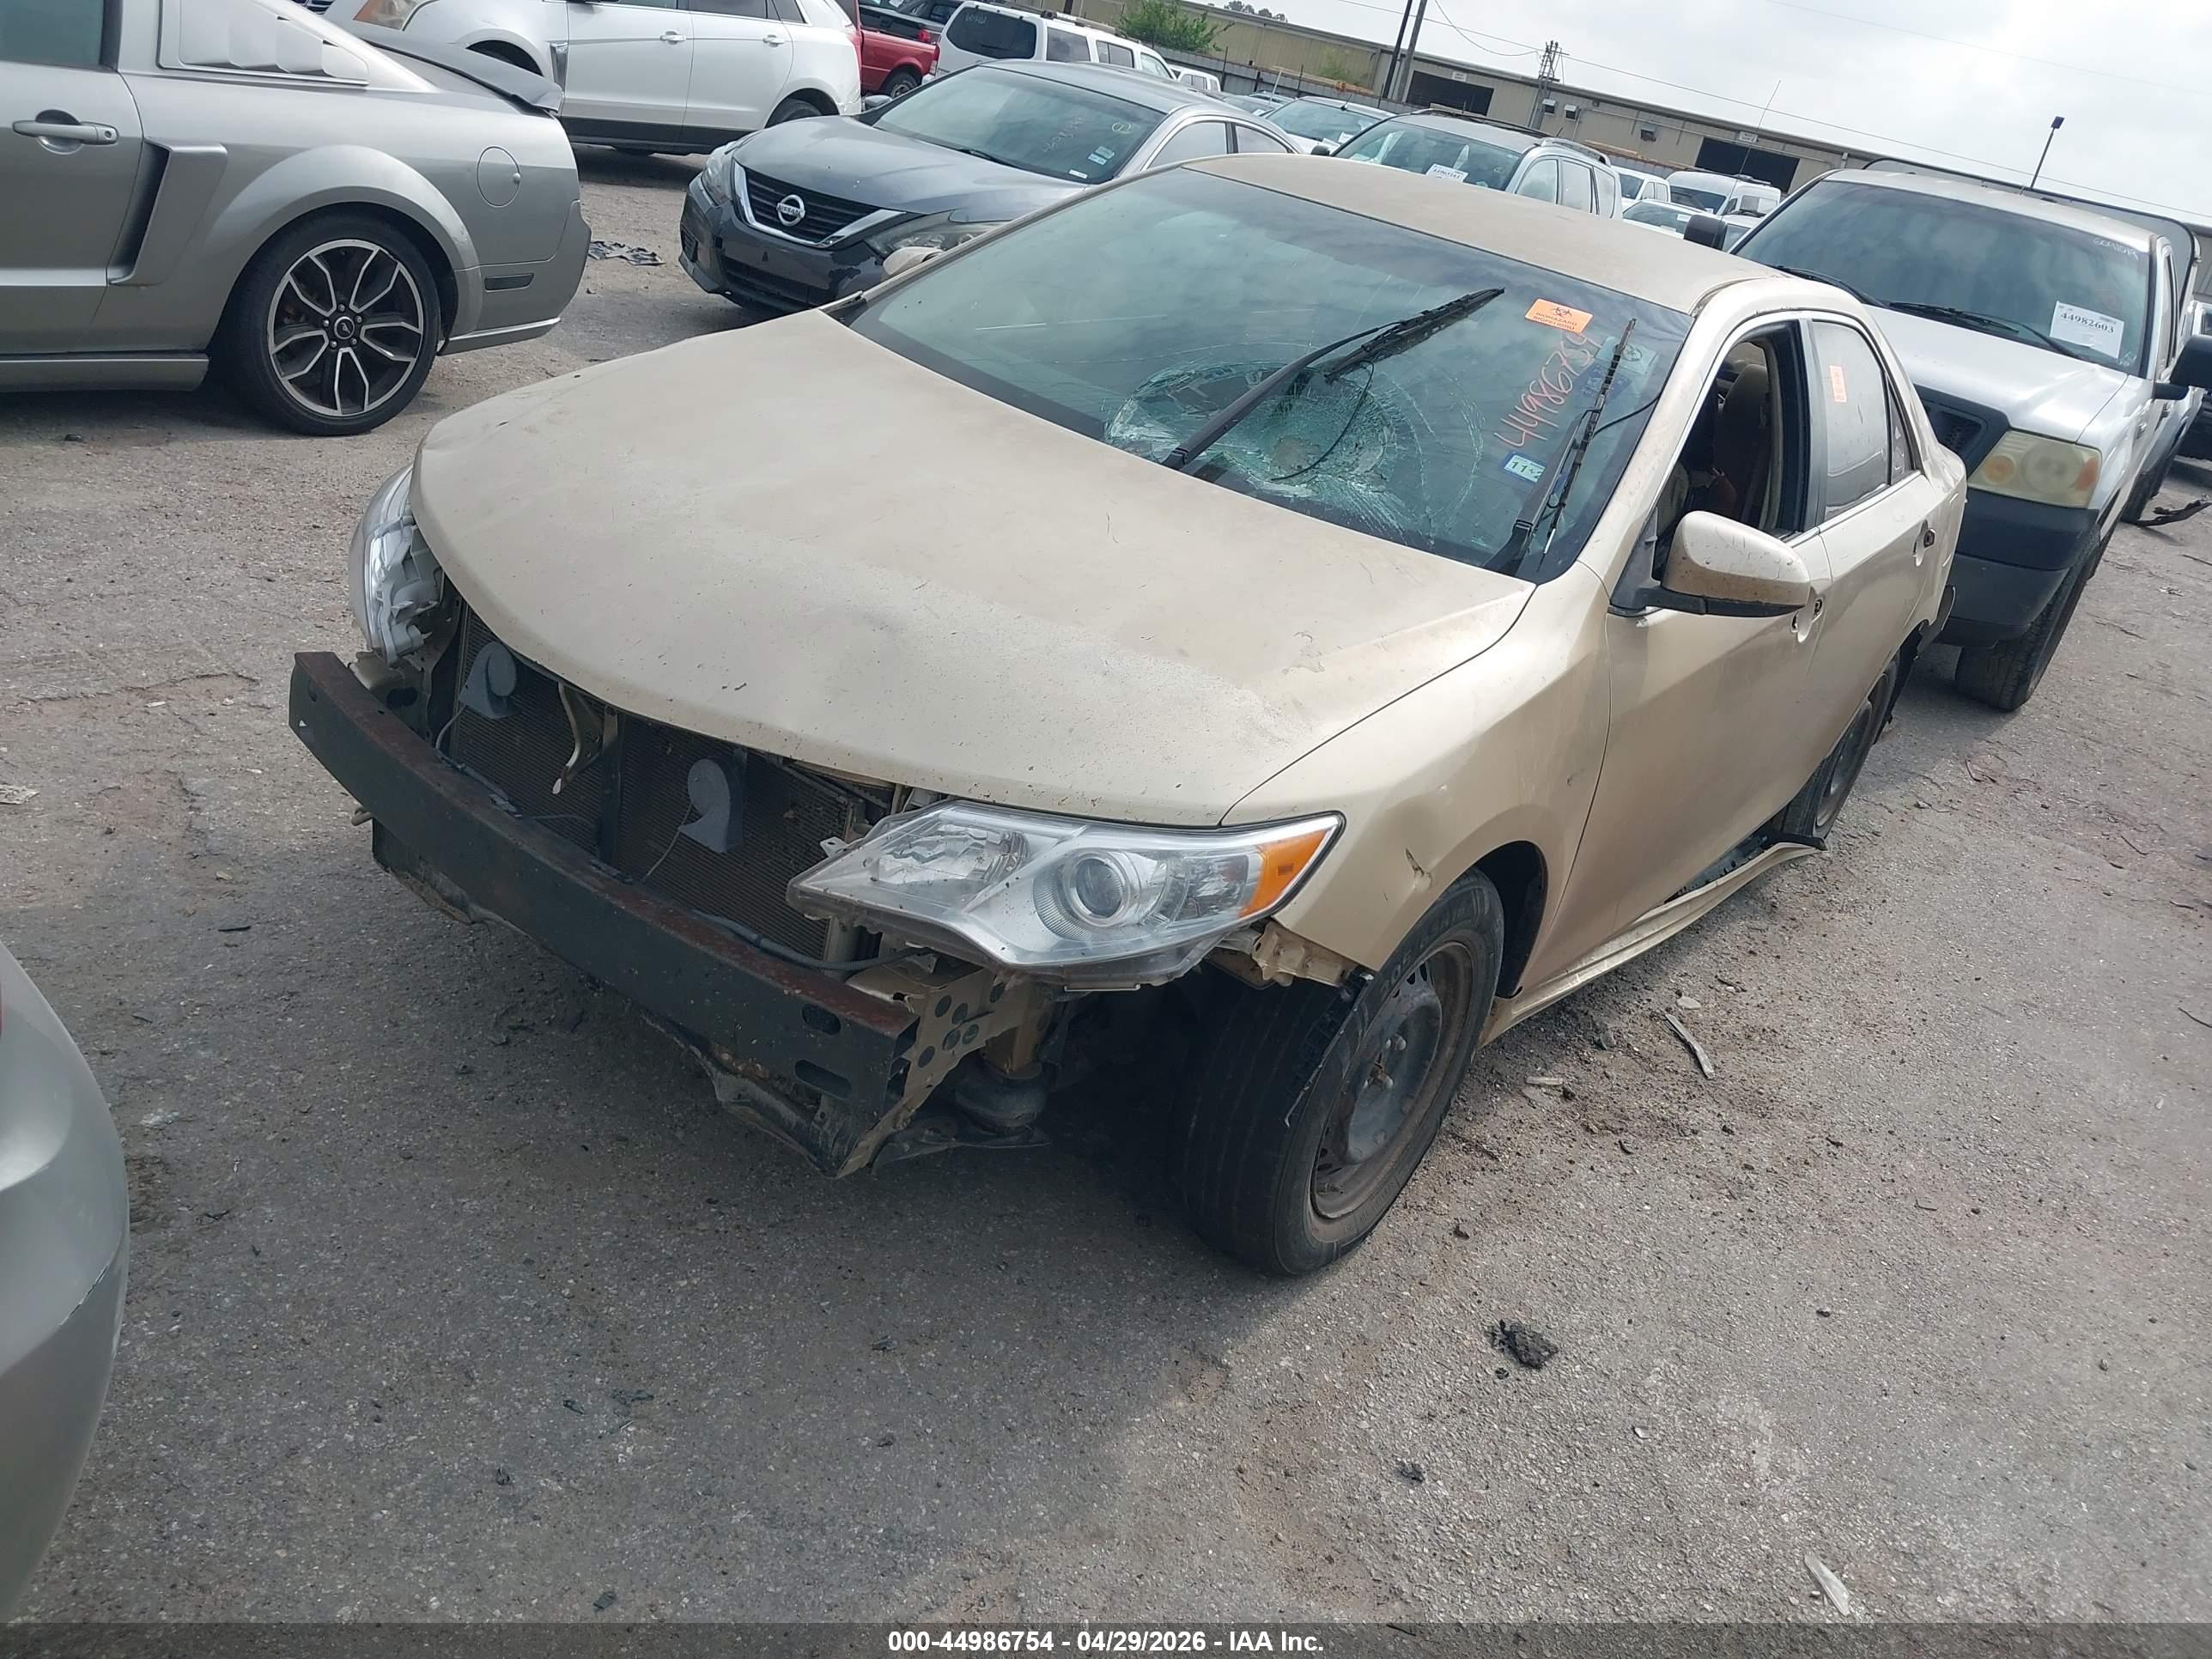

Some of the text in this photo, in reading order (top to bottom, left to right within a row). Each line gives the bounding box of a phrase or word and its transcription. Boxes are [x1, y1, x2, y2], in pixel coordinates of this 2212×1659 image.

[1535, 312, 1577, 326] BIOHAZARD
[2061, 313, 2114, 333] 44982603
[1493, 333, 1604, 447] 44986754
